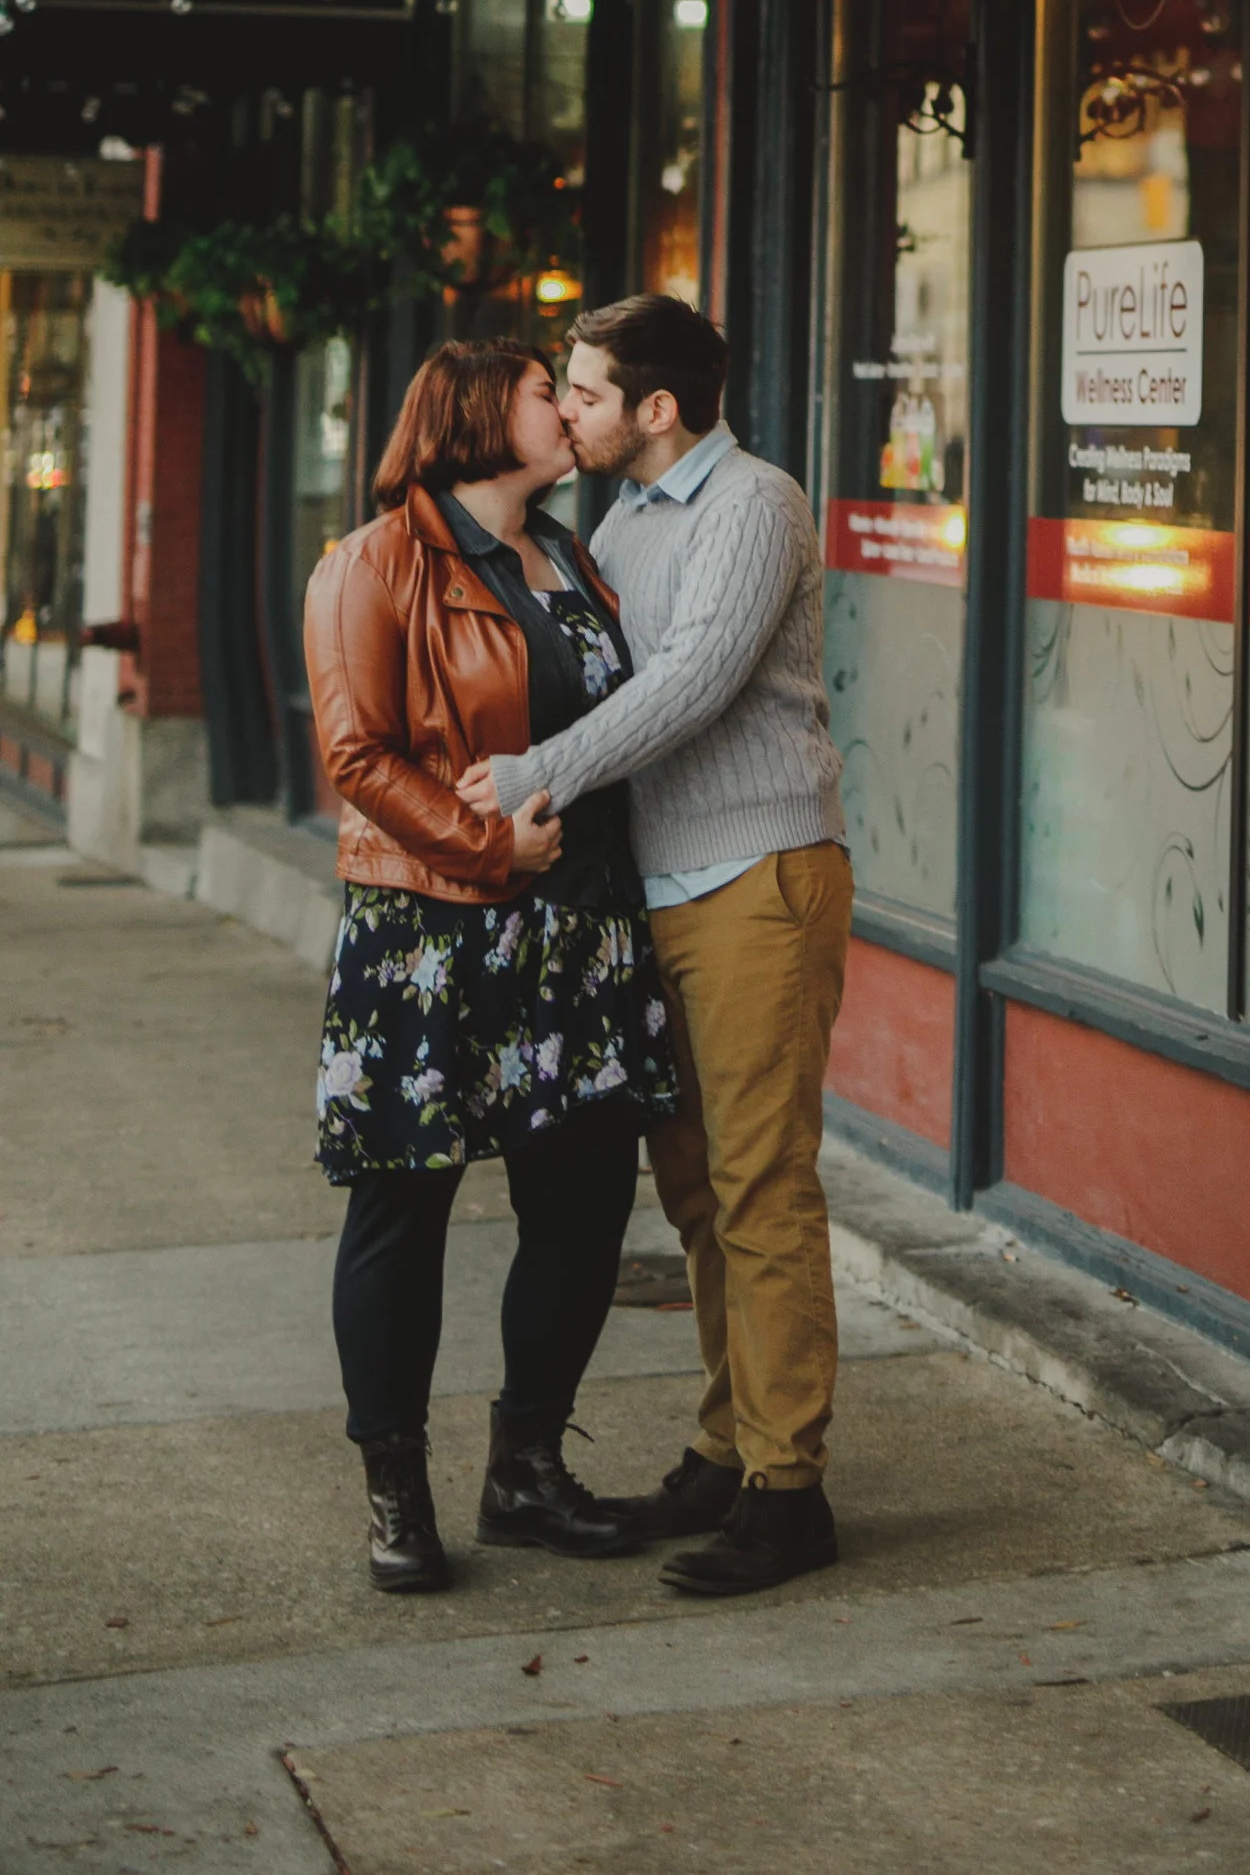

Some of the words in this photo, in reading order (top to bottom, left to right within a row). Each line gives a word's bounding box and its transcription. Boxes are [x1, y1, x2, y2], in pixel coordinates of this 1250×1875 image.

[1076, 260, 1188, 341] PureLife
[1075, 367, 1133, 404] Wellness
[1138, 367, 1187, 405] Center
